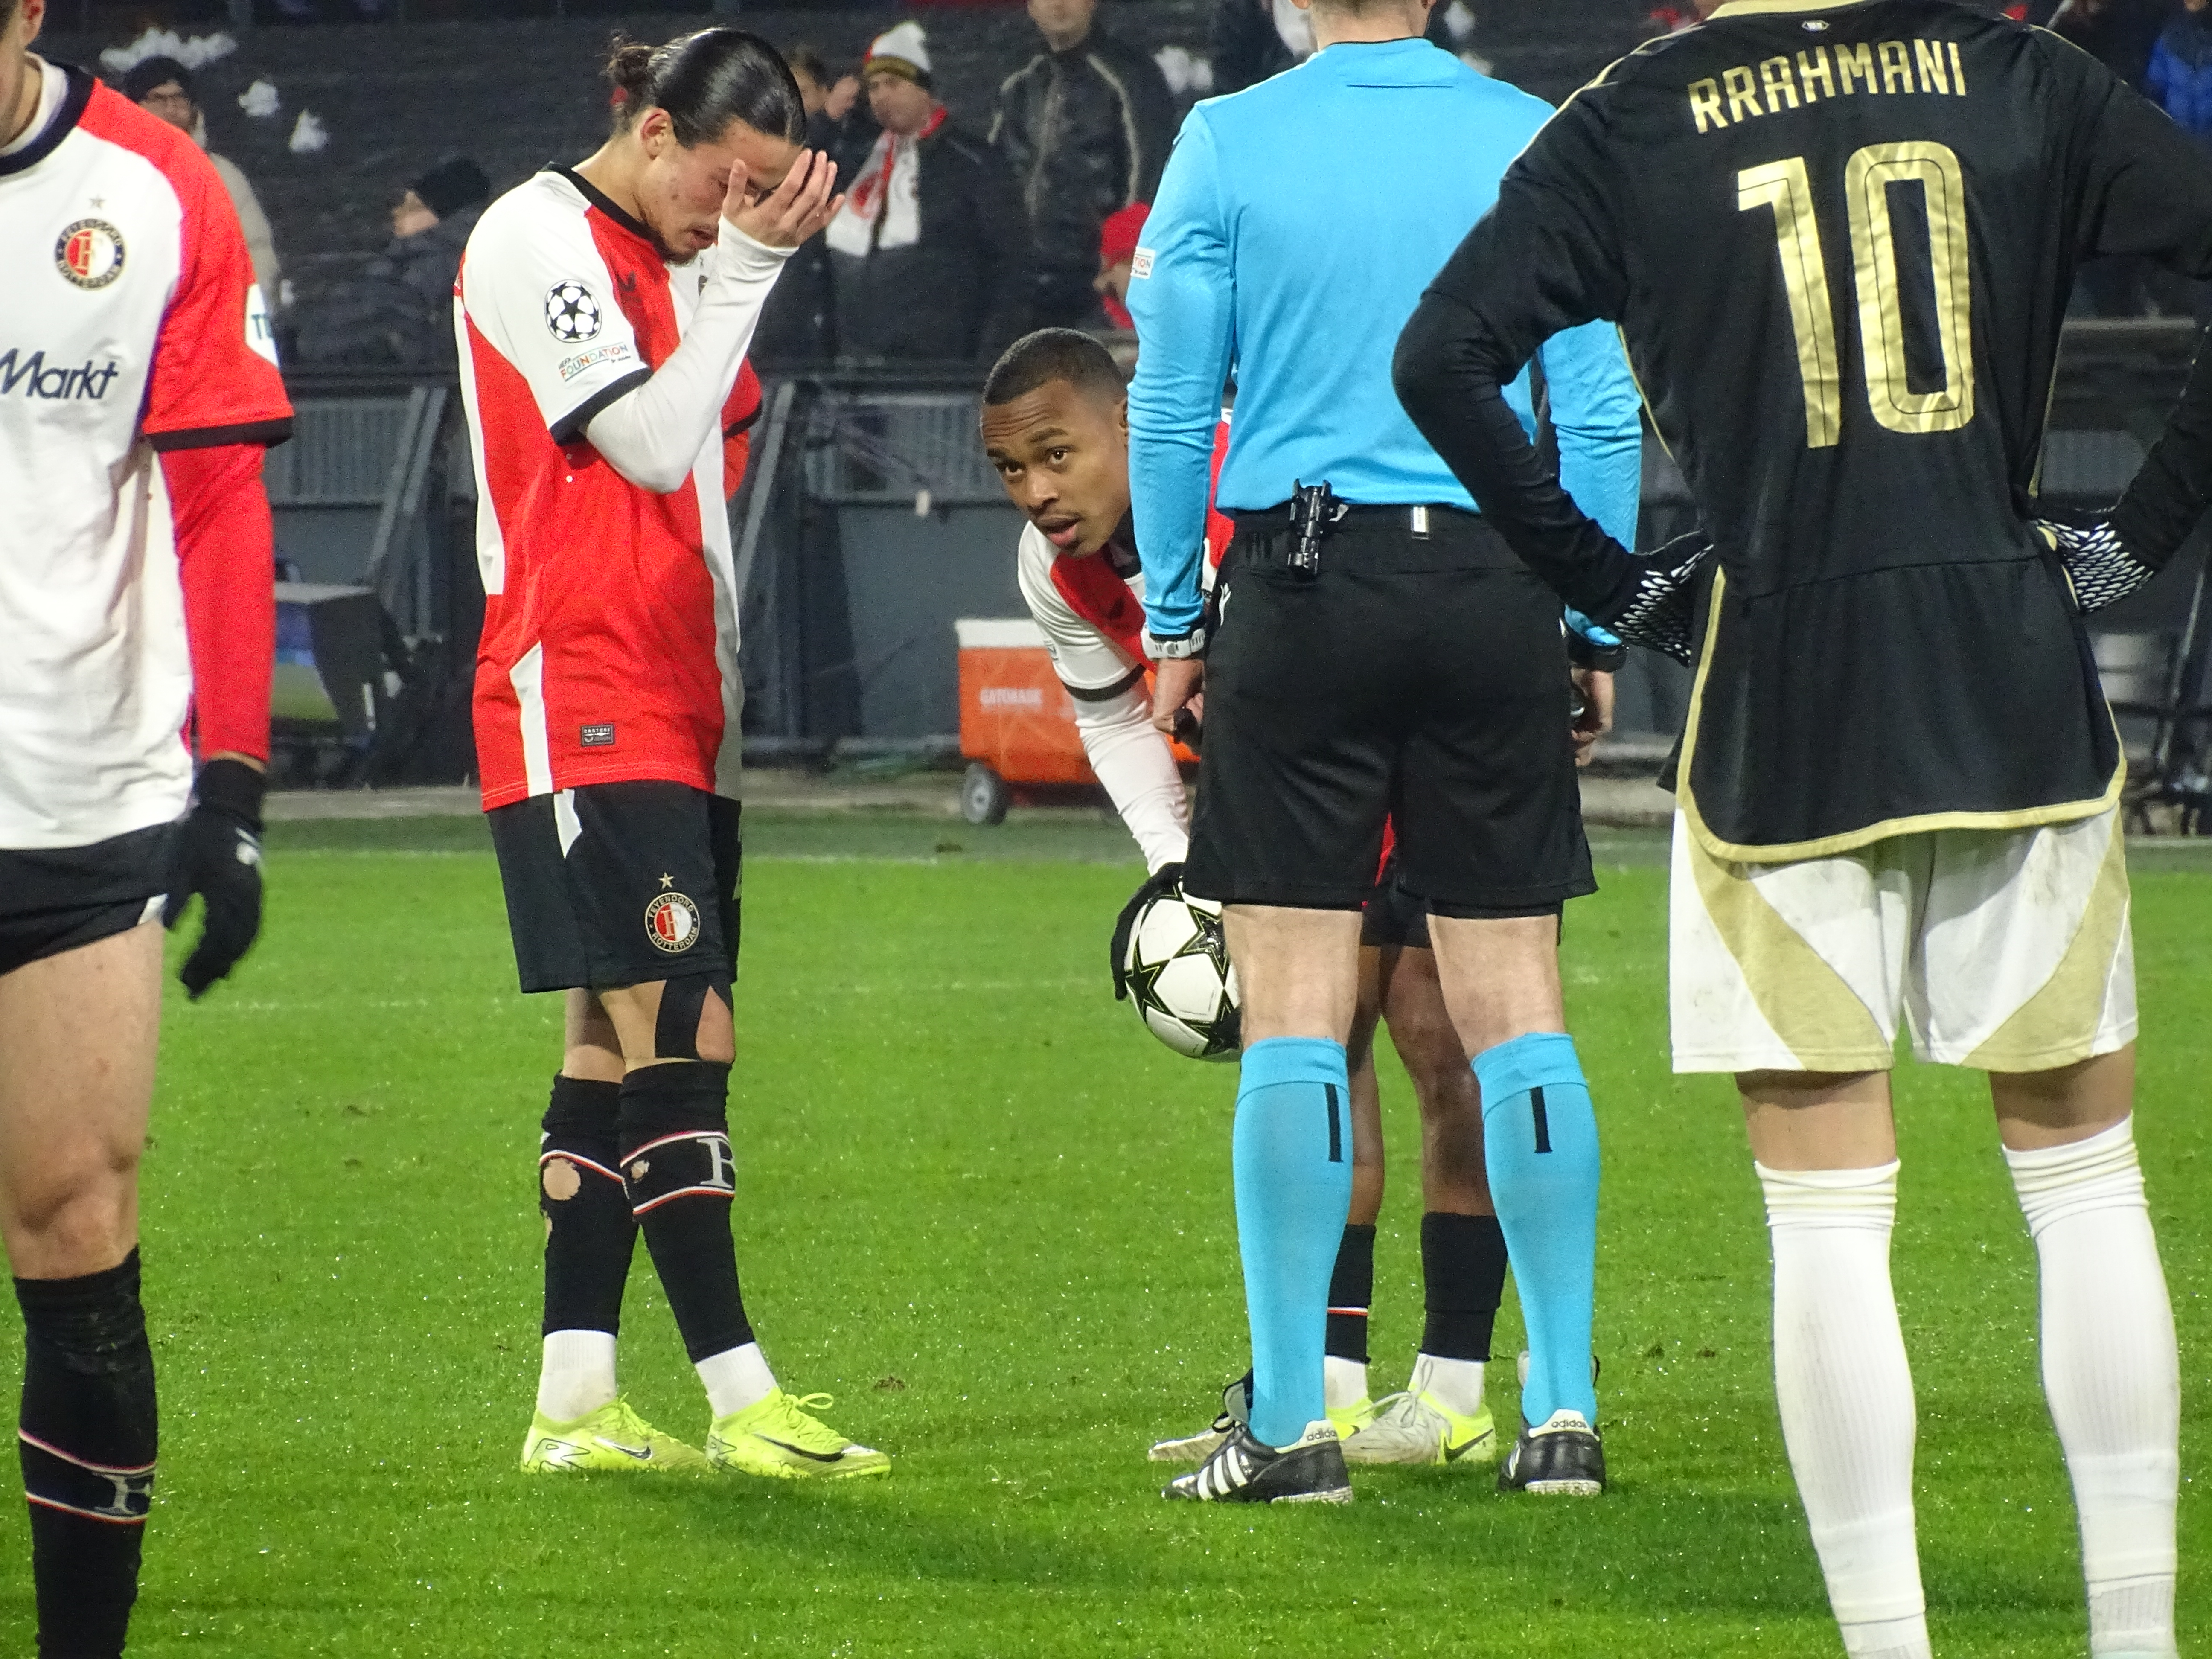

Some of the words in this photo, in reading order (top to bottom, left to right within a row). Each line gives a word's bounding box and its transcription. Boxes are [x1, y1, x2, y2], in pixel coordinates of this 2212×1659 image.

[1688, 39, 1965, 133] RRAHMANI
[1738, 140, 1974, 448] 10
[0, 348, 119, 399] Markt
[560, 344, 628, 379] FOUNDATION
[648, 896, 694, 918] FEYENOORD
[652, 926, 698, 950] ROTTERDAM
